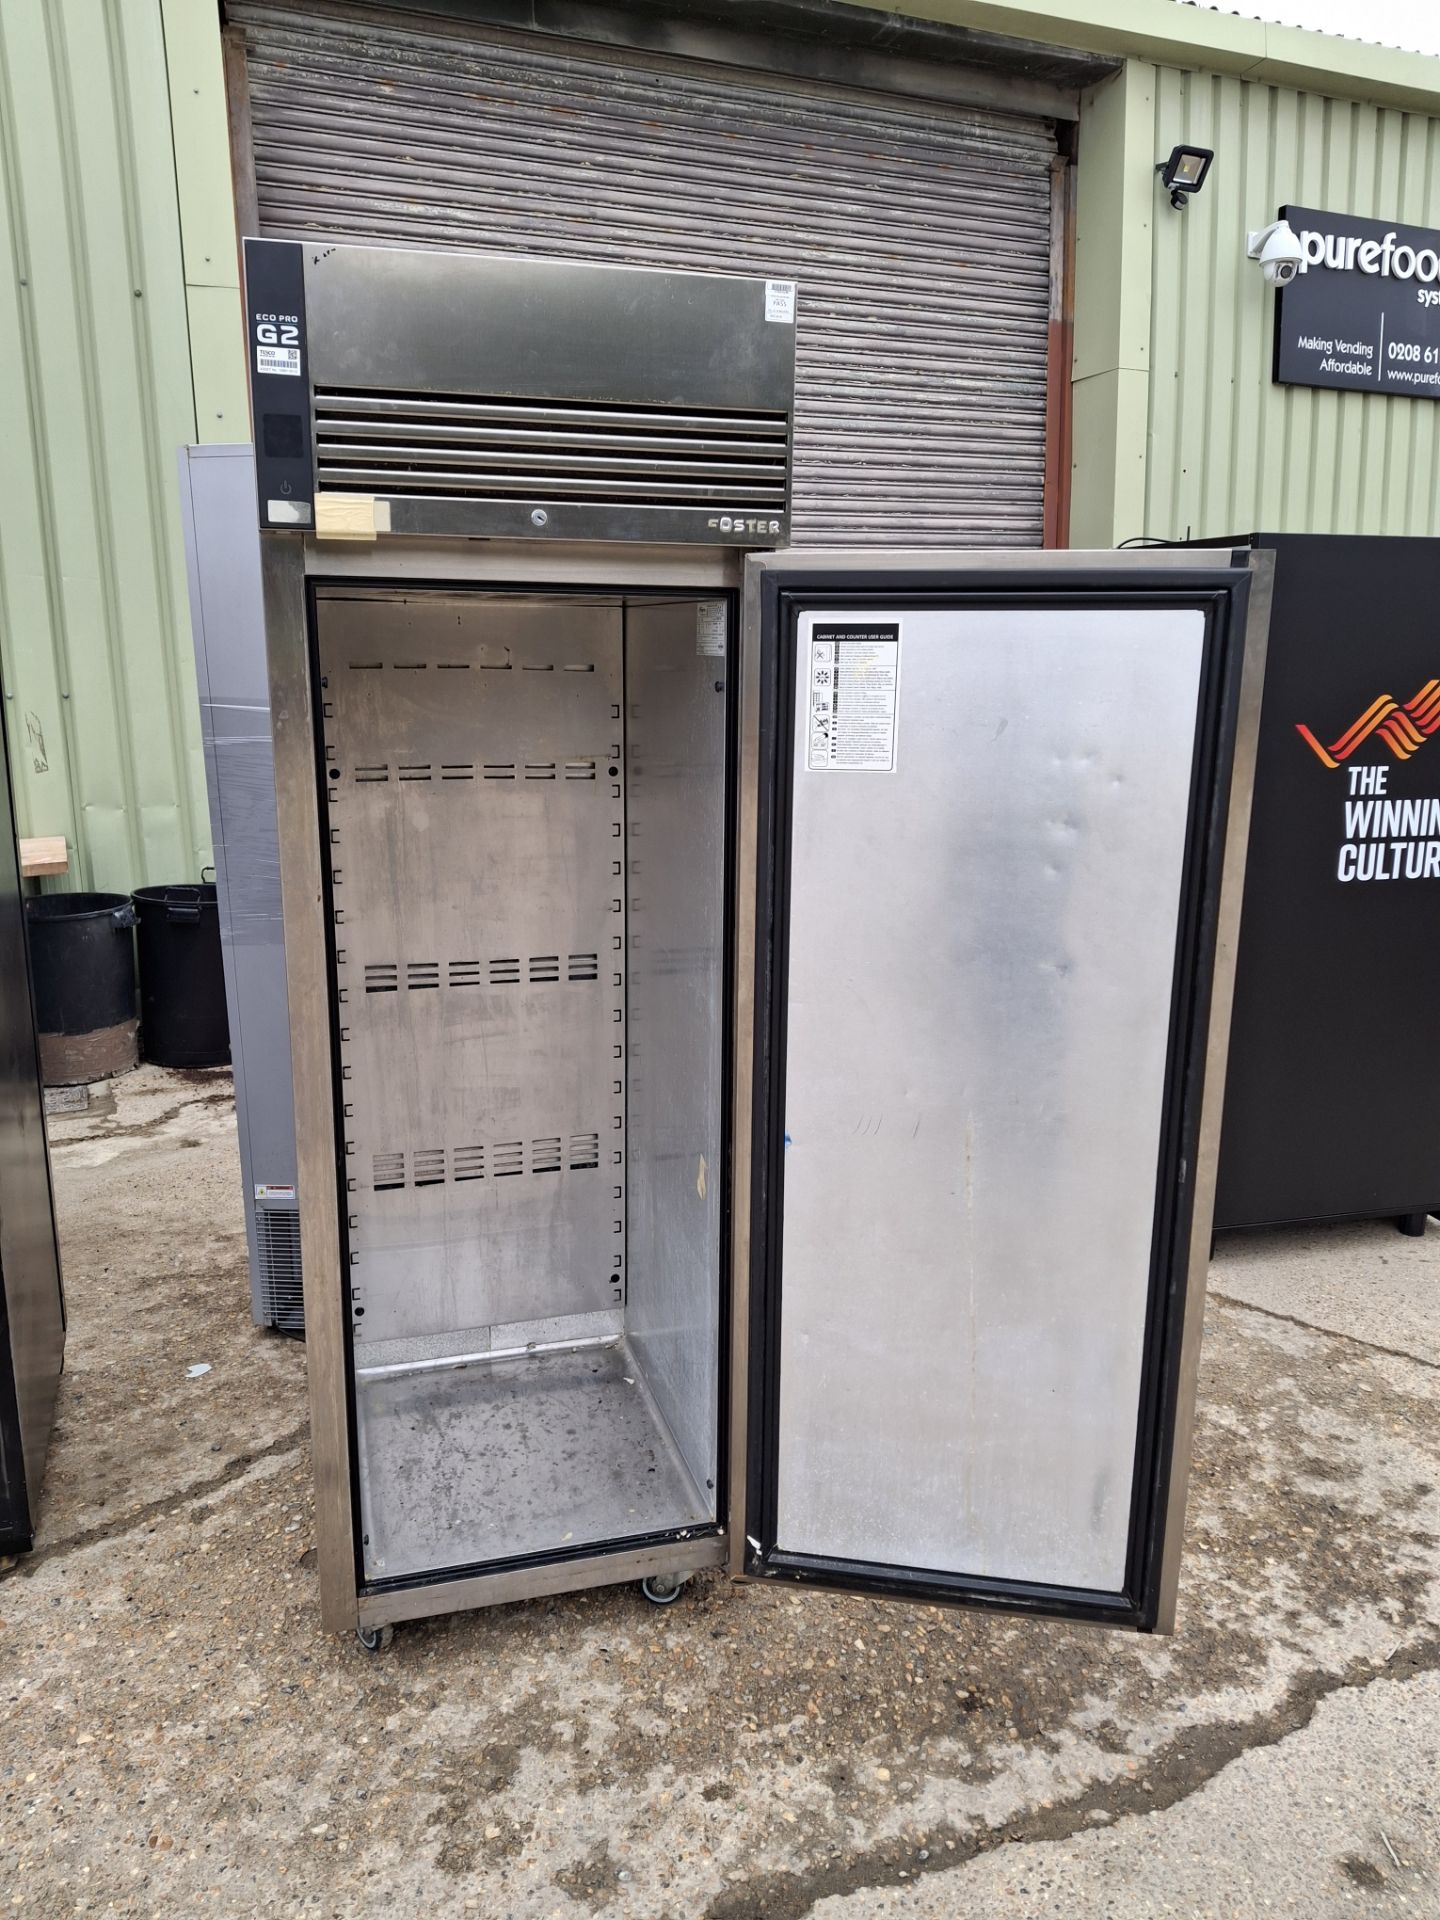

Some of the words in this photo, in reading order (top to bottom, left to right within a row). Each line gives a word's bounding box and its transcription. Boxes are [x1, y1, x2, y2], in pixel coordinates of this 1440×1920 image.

[1299, 231, 1440, 282] purefoo
[1417, 289, 1440, 308] sys
[279, 315, 298, 323] PRO
[257, 324, 299, 345] G2
[1298, 336, 1333, 354] Making
[1335, 339, 1374, 359] Vending
[1388, 342, 1421, 362] 0208
[1320, 358, 1372, 375] Affordable
[1348, 766, 1389, 795] THE
[1337, 841, 1440, 882] CULTUR
